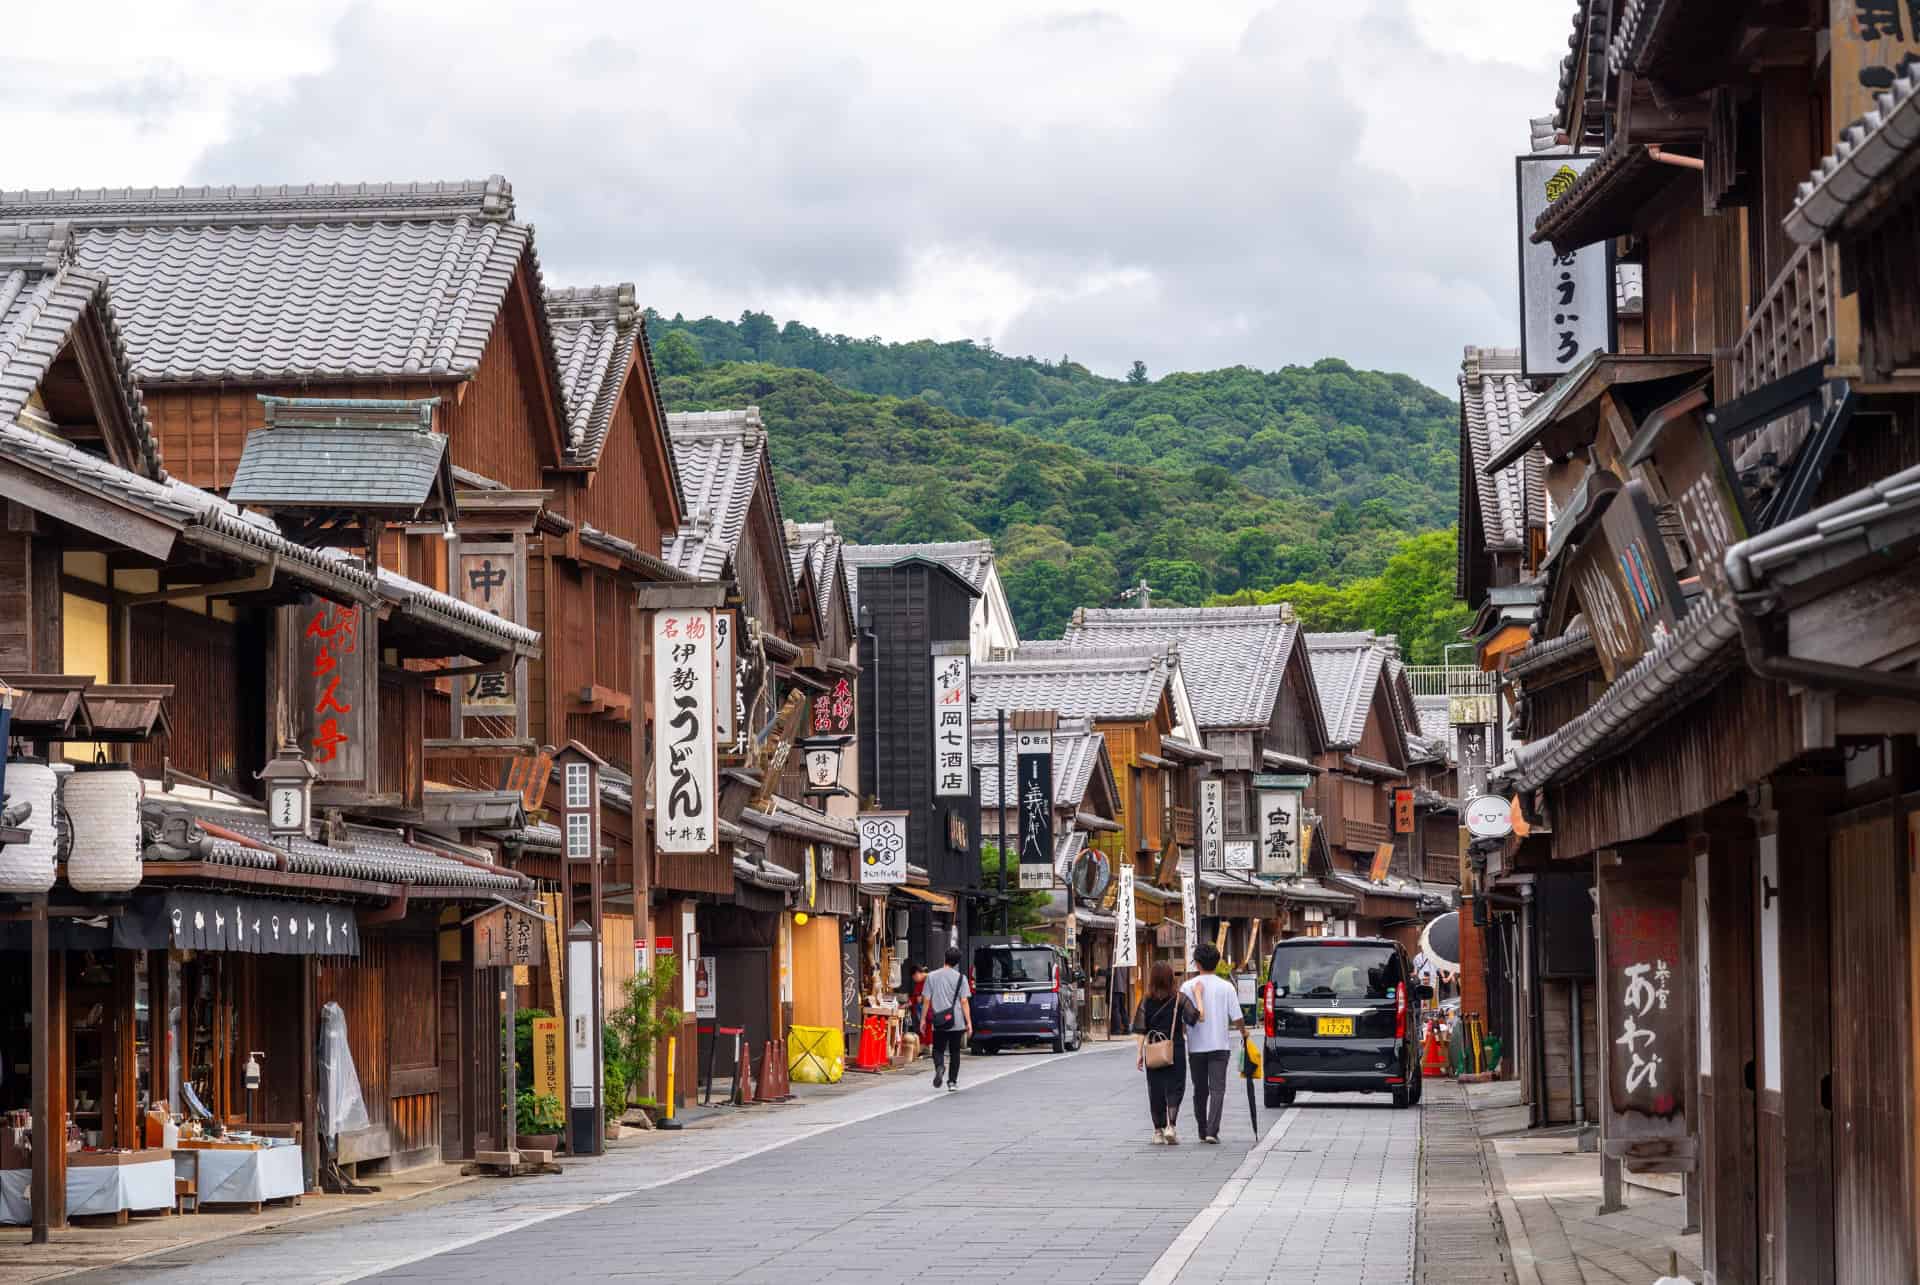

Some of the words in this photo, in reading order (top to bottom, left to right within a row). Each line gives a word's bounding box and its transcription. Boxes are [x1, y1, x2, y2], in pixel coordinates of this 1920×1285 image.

[468, 560, 510, 699] 中屋
[660, 617, 705, 640] 名物
[305, 598, 352, 764] んらん亭
[668, 643, 702, 821] 伊勢うどん
[939, 711, 963, 790] 岡七酒店
[664, 826, 707, 842] 中井屋
[1205, 783, 1219, 835] 伊勢うどん
[1264, 806, 1295, 859] 白鷹
[1615, 962, 1663, 1094] あわび
